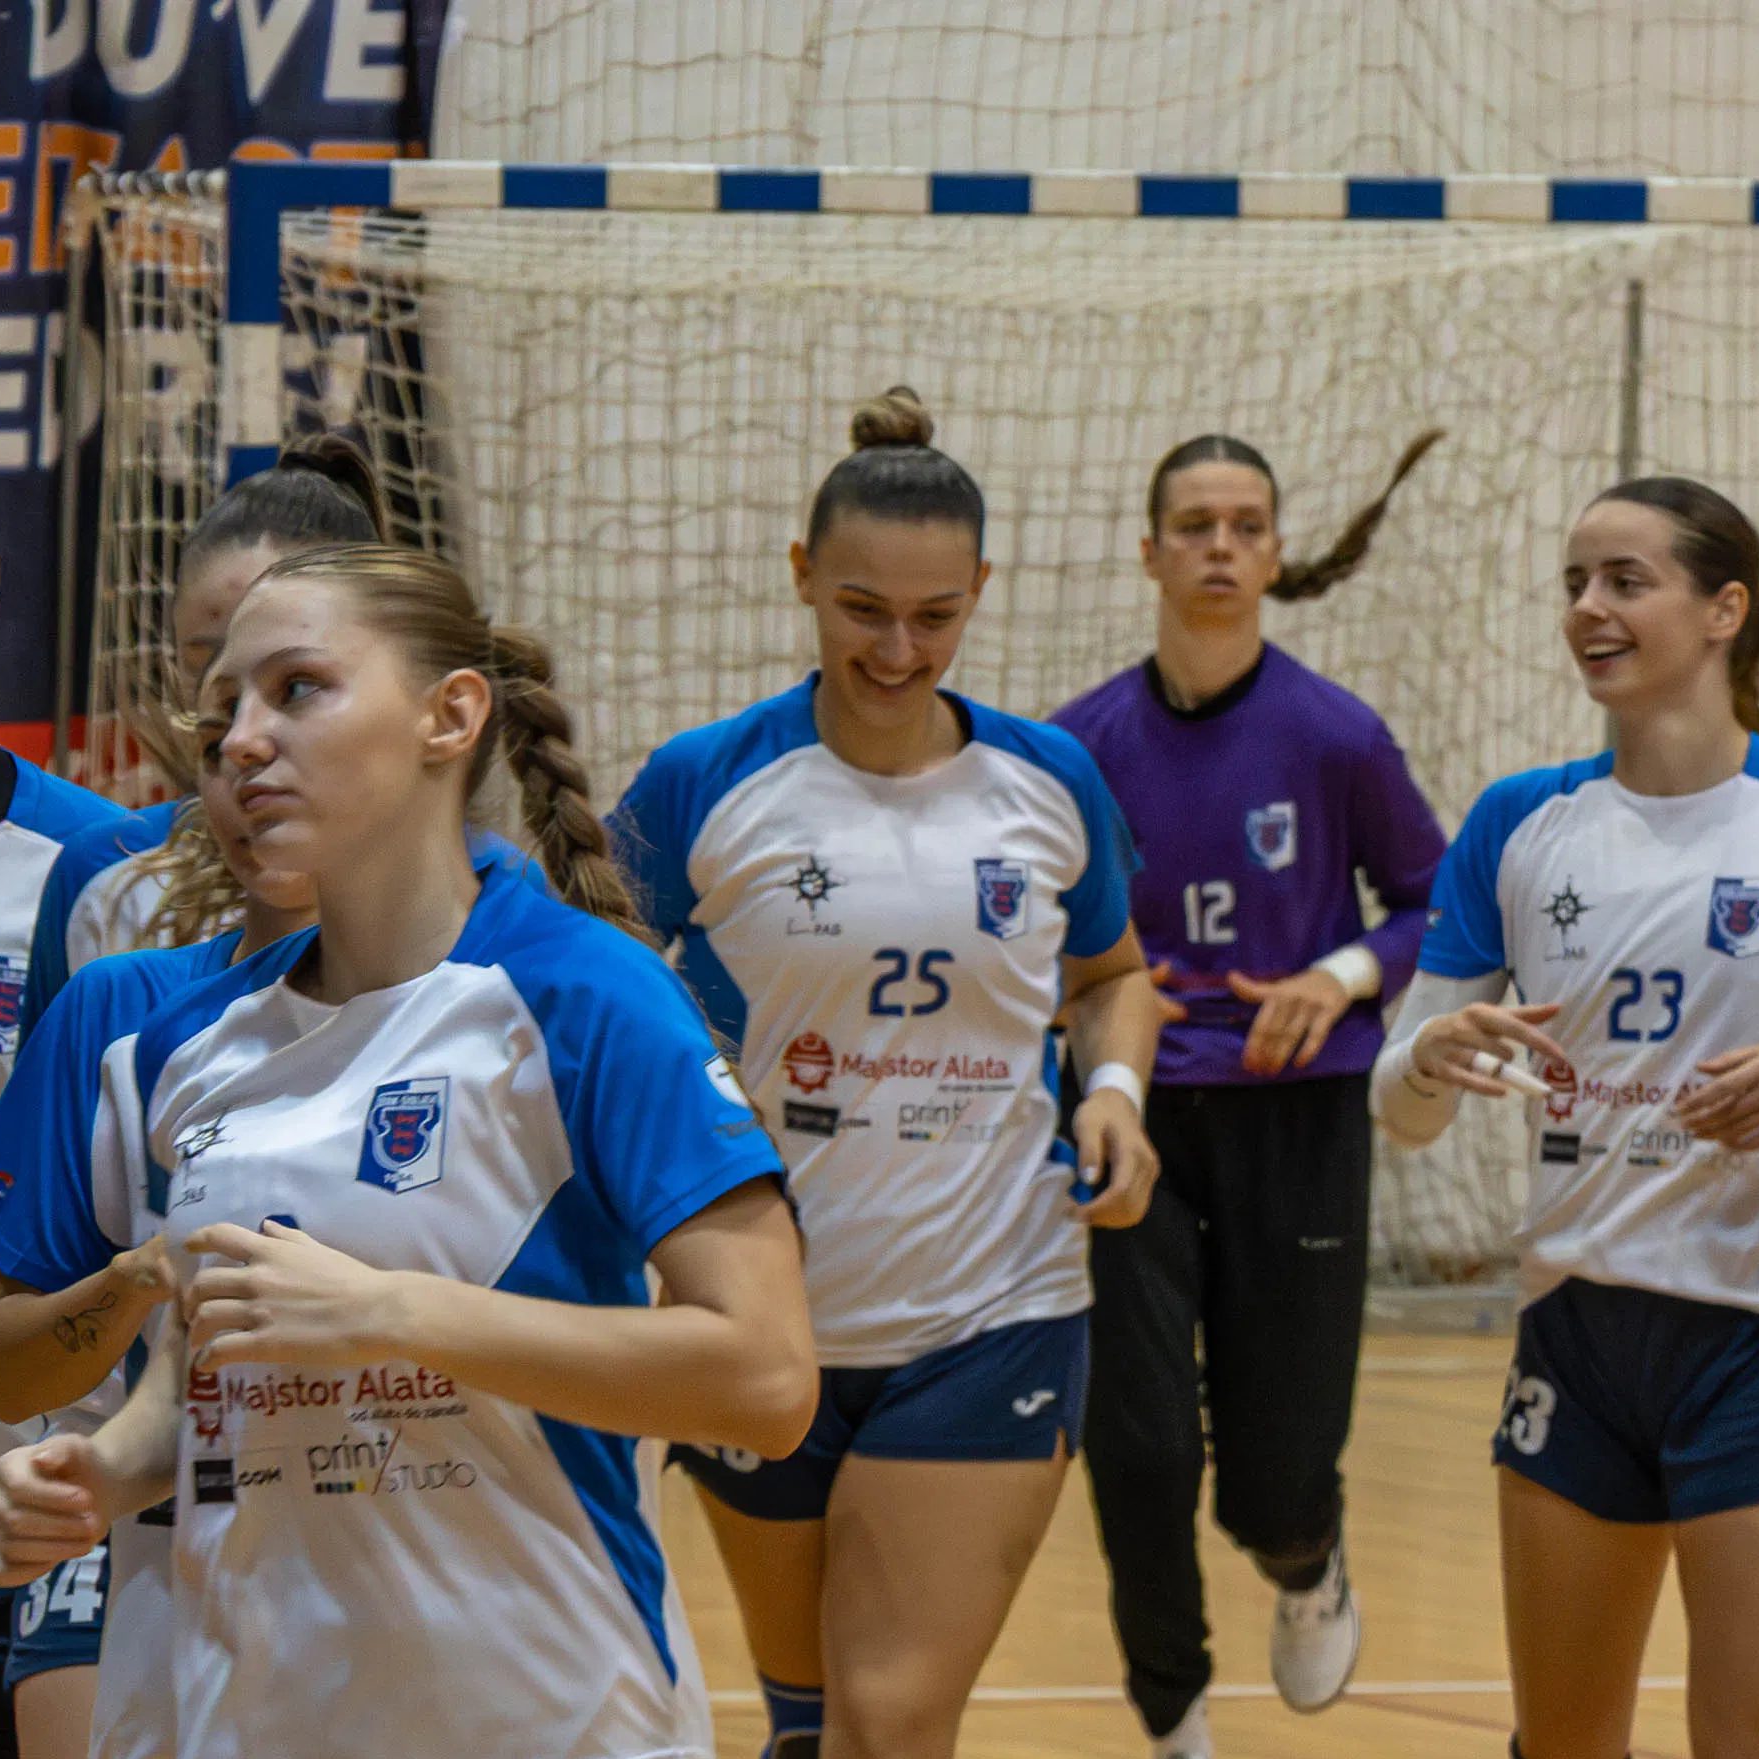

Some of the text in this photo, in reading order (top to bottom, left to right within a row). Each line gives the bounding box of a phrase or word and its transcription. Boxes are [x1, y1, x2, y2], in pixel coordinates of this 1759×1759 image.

[1183, 880, 1238, 945] 12
[868, 947, 956, 1018] 25
[1608, 968, 1685, 1042] 23
[943, 1055, 1011, 1080] Alata
[228, 1371, 345, 1417] Majstor
[355, 1366, 457, 1404] Alata
[307, 1433, 389, 1480] print
